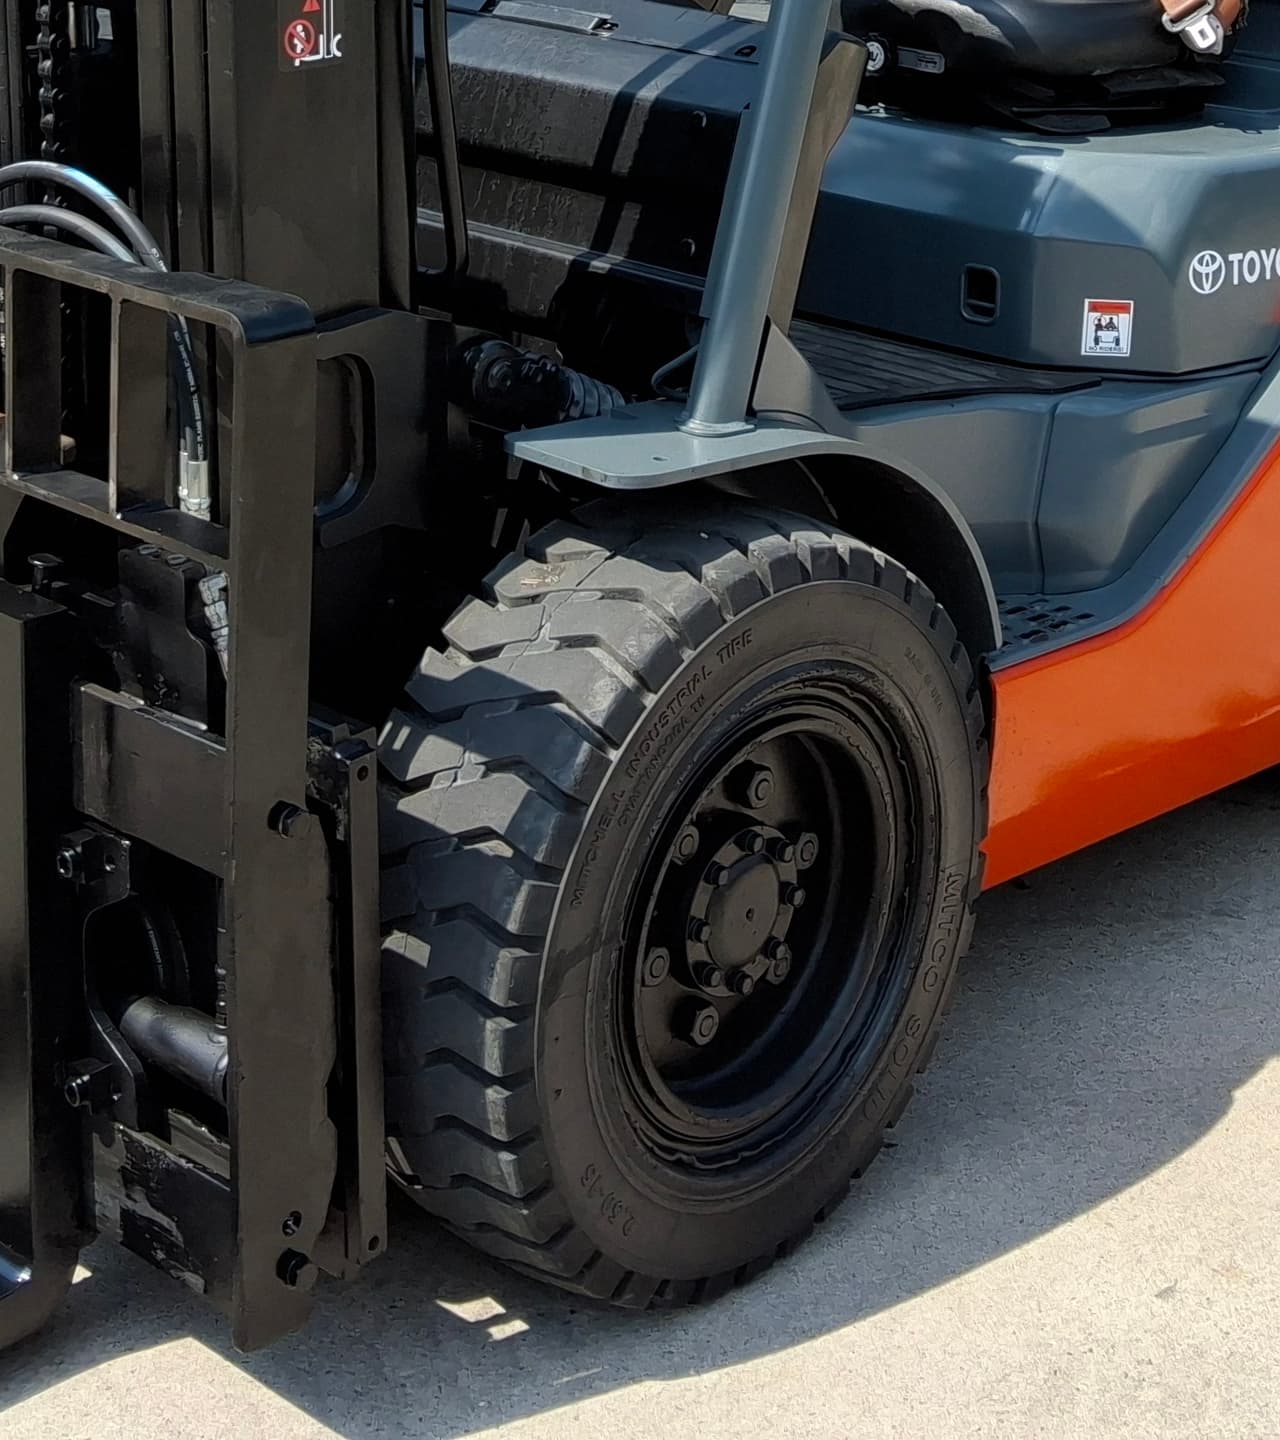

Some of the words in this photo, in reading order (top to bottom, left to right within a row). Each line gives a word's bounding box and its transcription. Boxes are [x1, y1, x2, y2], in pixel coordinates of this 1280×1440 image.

[570, 788, 626, 906] MITCHELL
[624, 664, 713, 779] INDUSTRIAL
[716, 627, 753, 665] TIRE
[922, 868, 965, 993] MITCO
